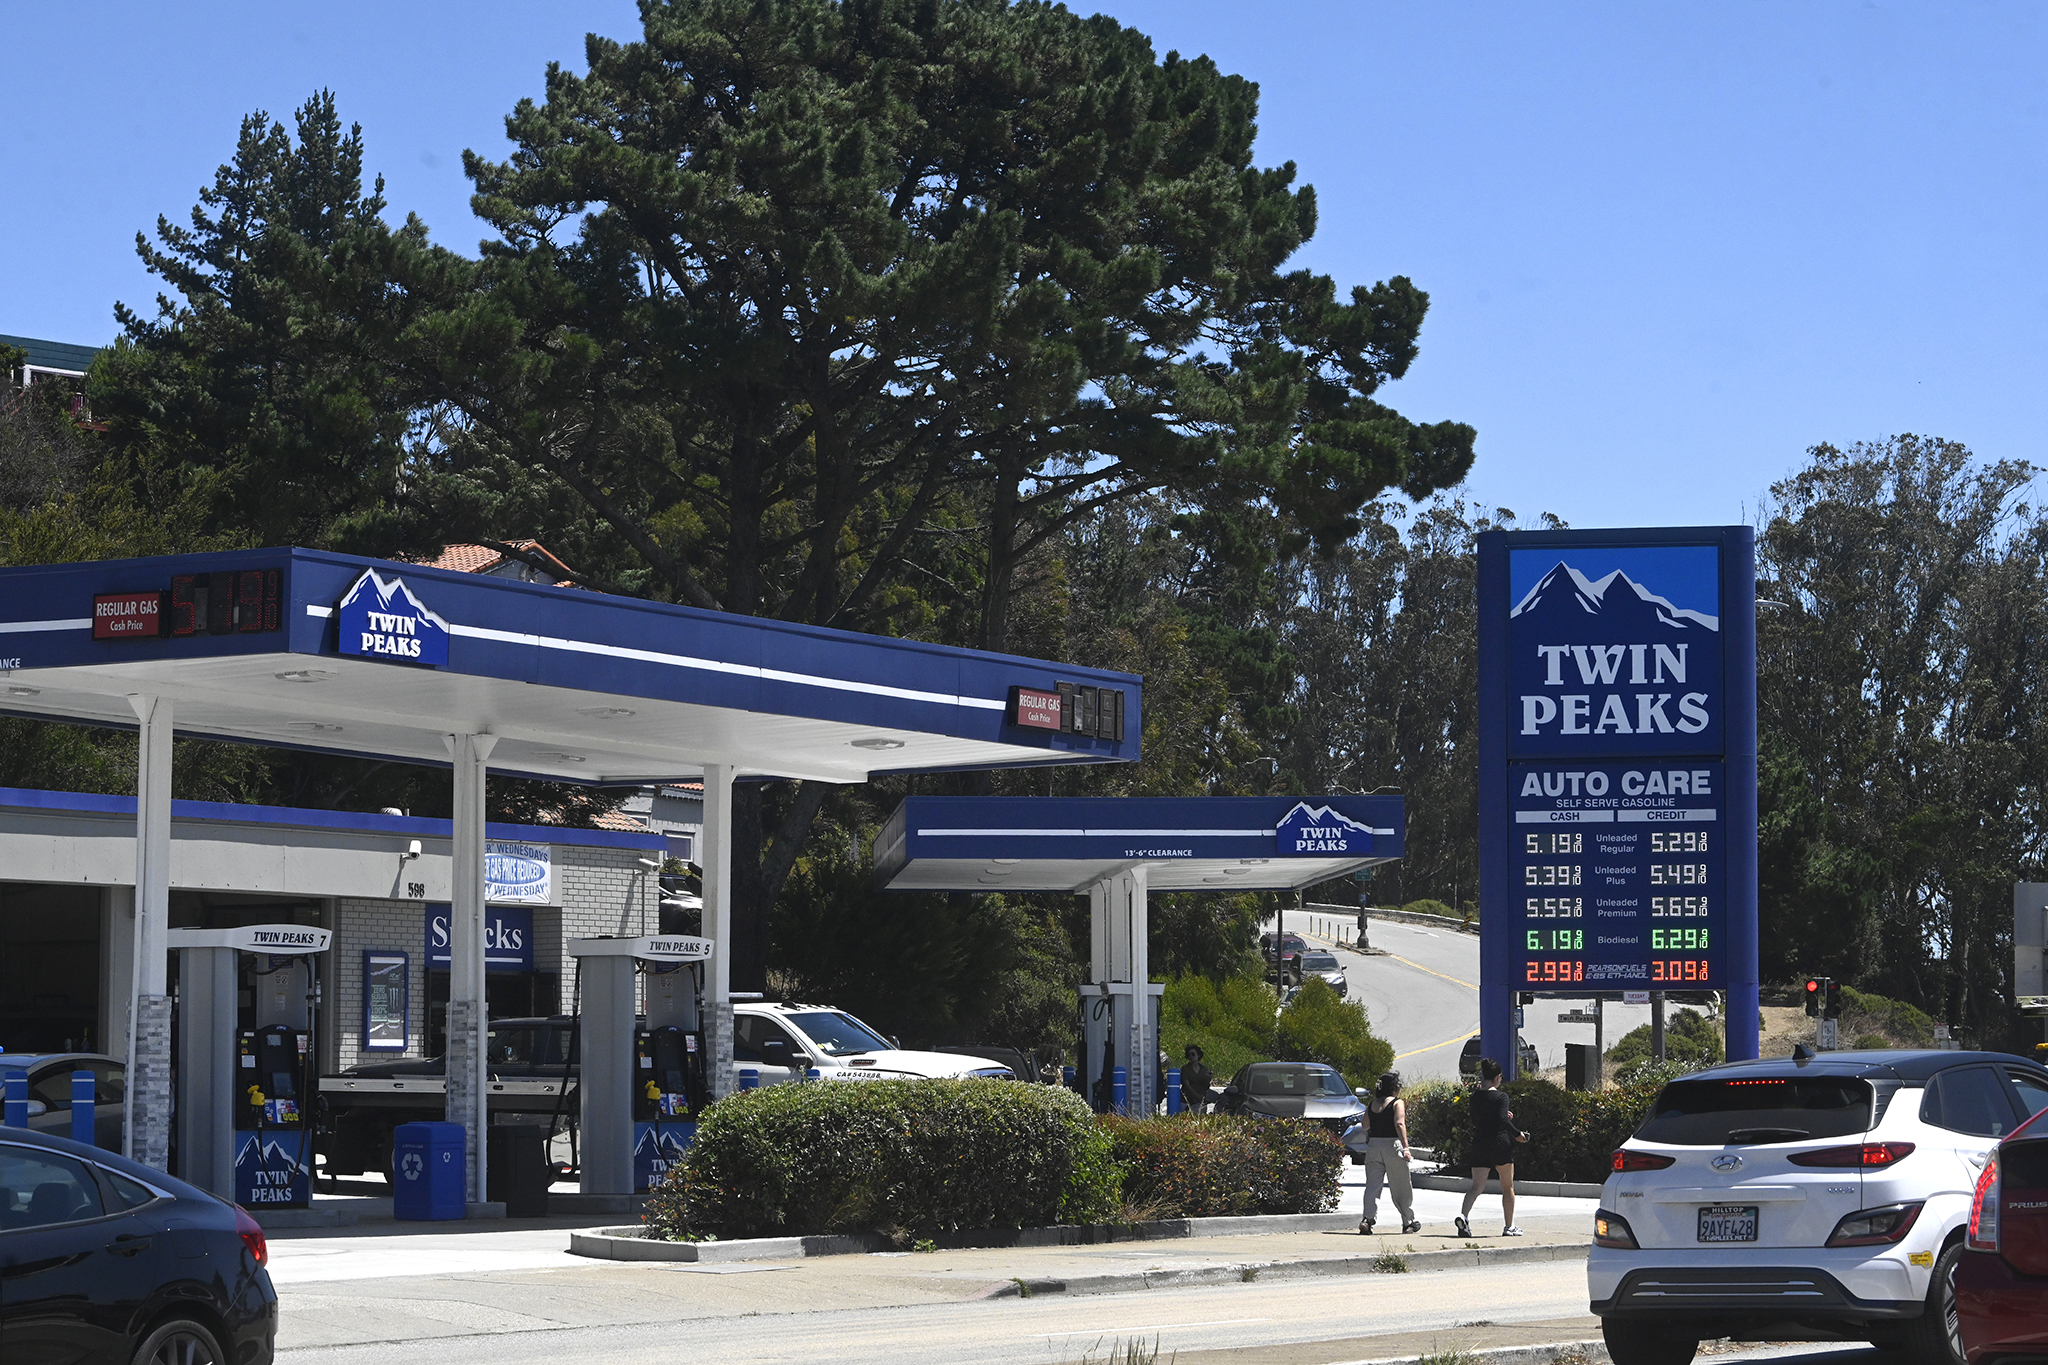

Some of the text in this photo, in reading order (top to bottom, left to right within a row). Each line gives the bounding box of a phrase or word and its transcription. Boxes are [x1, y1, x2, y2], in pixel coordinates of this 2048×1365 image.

[96, 600, 158, 616] REGULAR GAS
[110, 620, 143, 631] Cash Price
[368, 611, 416, 635] TWIN
[361, 633, 421, 657] PEAKS
[1537, 643, 1688, 685] TWIN
[1019, 694, 1060, 711] REGULAR GAS
[1028, 712, 1050, 723] Cash Price
[1520, 692, 1710, 735] PEAKS
[1520, 770, 1712, 797] AUTO CARE
[1556, 798, 1675, 808] SELF SERVE GASOLINE
[1550, 812, 1580, 821] CASH
[1647, 811, 1687, 820] CREDIT
[1300, 827, 1342, 839] TWIN
[1596, 834, 1638, 843] Unleaded
[1296, 839, 1348, 851] PEAKS
[1600, 845, 1635, 855] Regular
[496, 843, 548, 863] WEDNESDAYS
[1147, 849, 1193, 857] CLEARANCE
[1594, 866, 1637, 875] Unleaded
[1606, 877, 1626, 885] Plus
[408, 882, 425, 898] 598
[1596, 899, 1638, 907] Unleaded
[1597, 909, 1637, 918] Premium
[253, 931, 327, 947] TWIN PEAKS 7
[431, 916, 522, 950] Scks
[1597, 936, 1639, 944] Biodiesel
[649, 941, 710, 955] TWIN PEAKS 5
[255, 1170, 288, 1185] TWIN
[251, 1188, 293, 1202] PEAKS
[1702, 1220, 1753, 1236] 9AYF428
